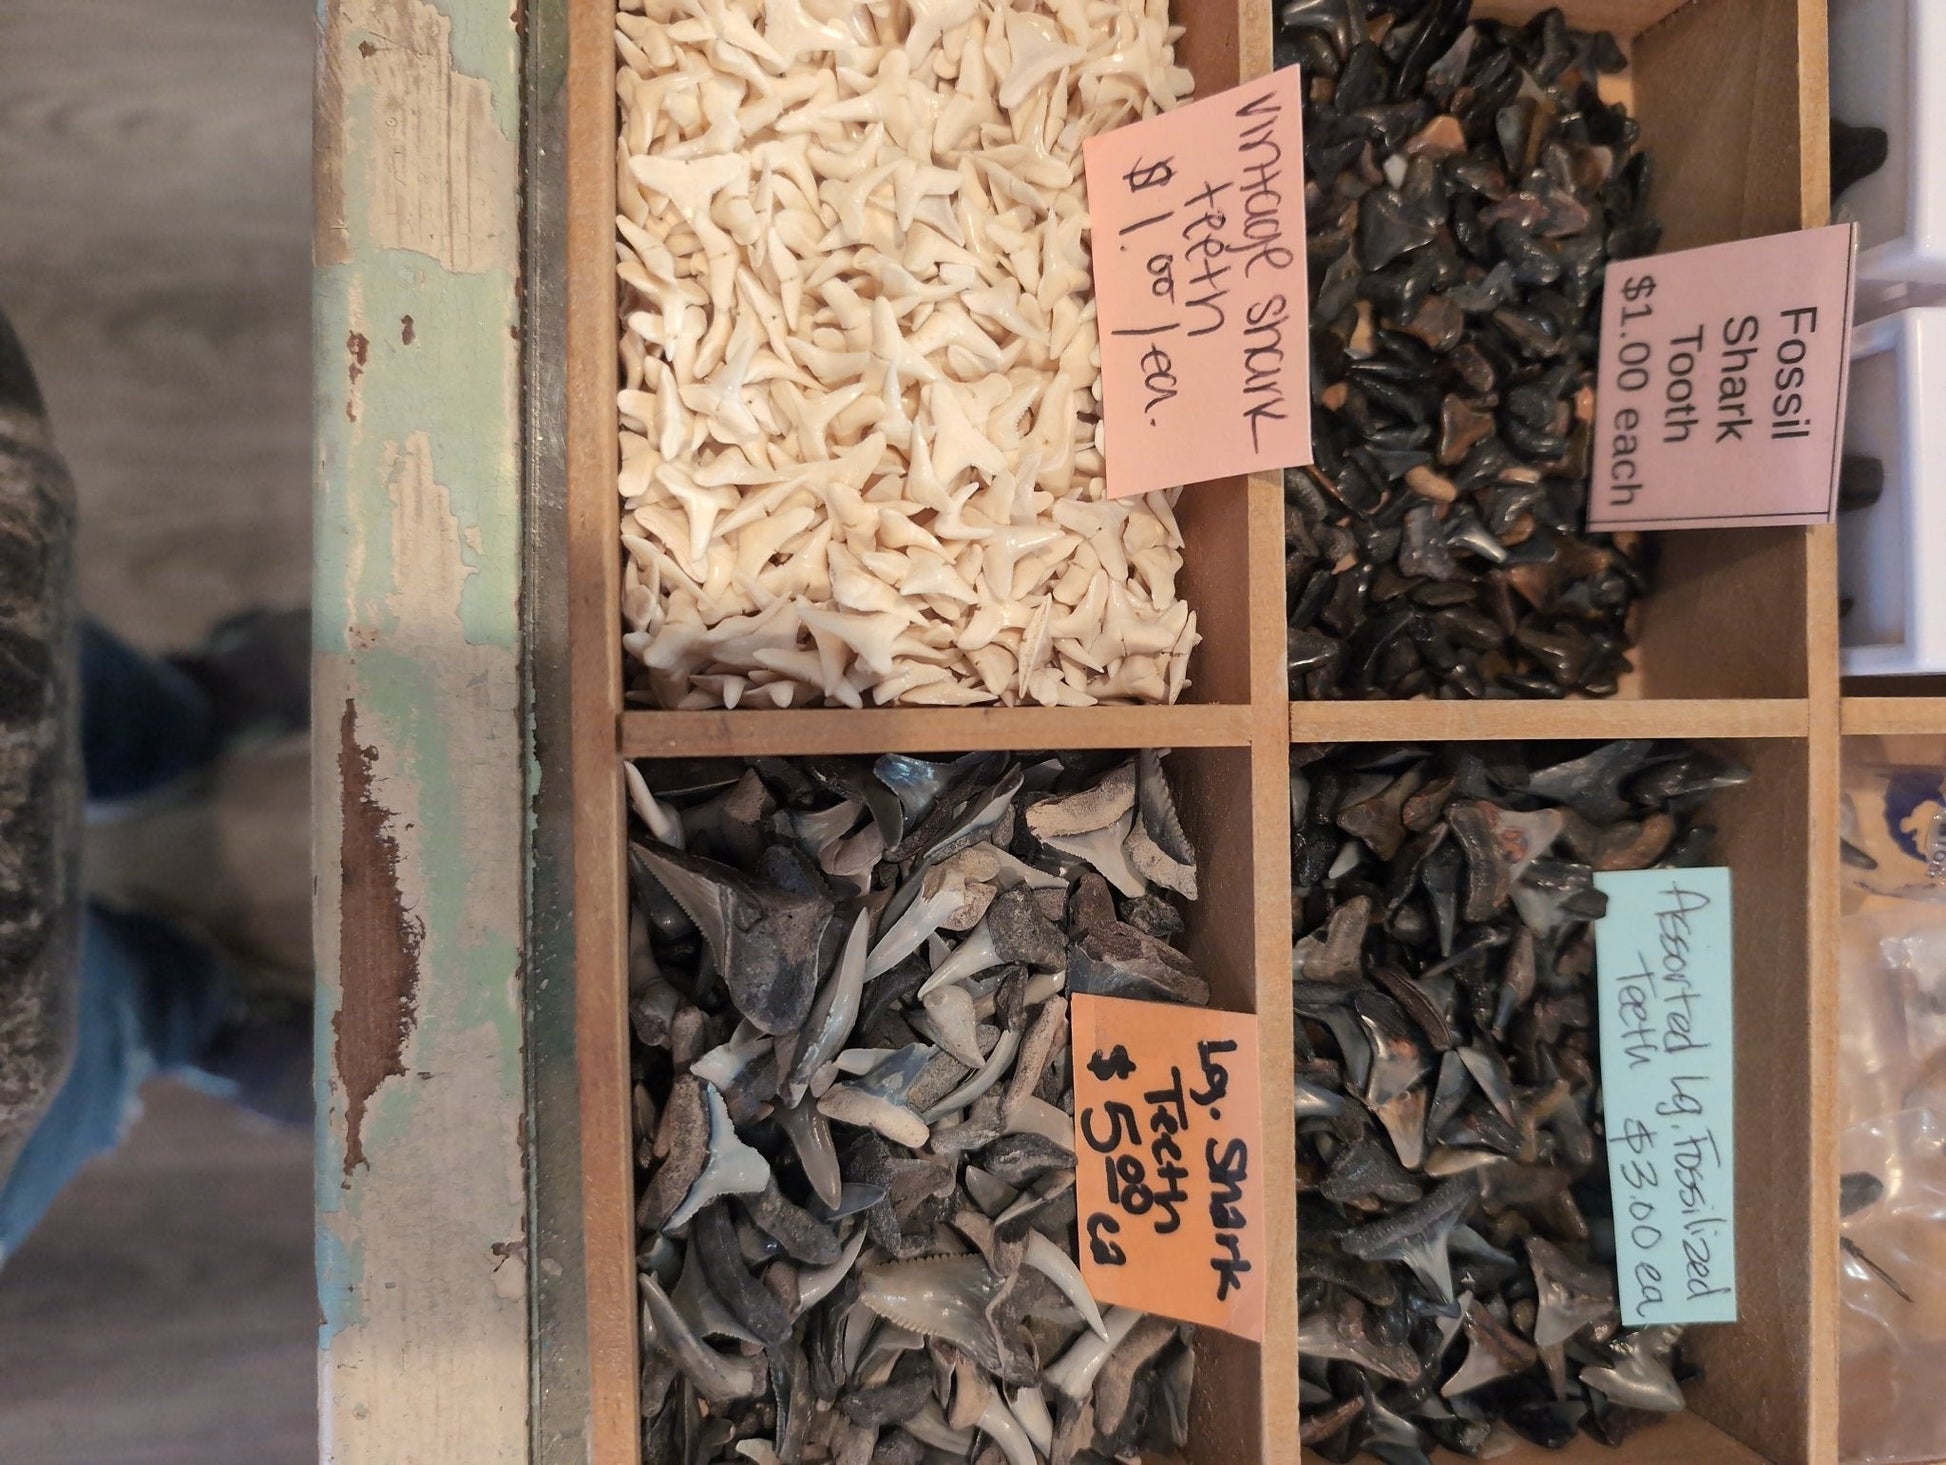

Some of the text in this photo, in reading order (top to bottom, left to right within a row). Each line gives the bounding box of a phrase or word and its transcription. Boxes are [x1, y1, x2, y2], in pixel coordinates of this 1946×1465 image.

[1183, 181, 1233, 336] teeth
[1609, 275, 1656, 506] $1.00 each
[1663, 324, 1704, 443] Tooth
[1716, 315, 1759, 443] Shark
[1771, 306, 1817, 439] Fossil
[1654, 881, 1711, 1052] Assorted
[1143, 1065, 1189, 1234] Teeth
[1608, 950, 1663, 1318] Teeth $3.00 ea
[1673, 1128, 1731, 1300] Fossilized
